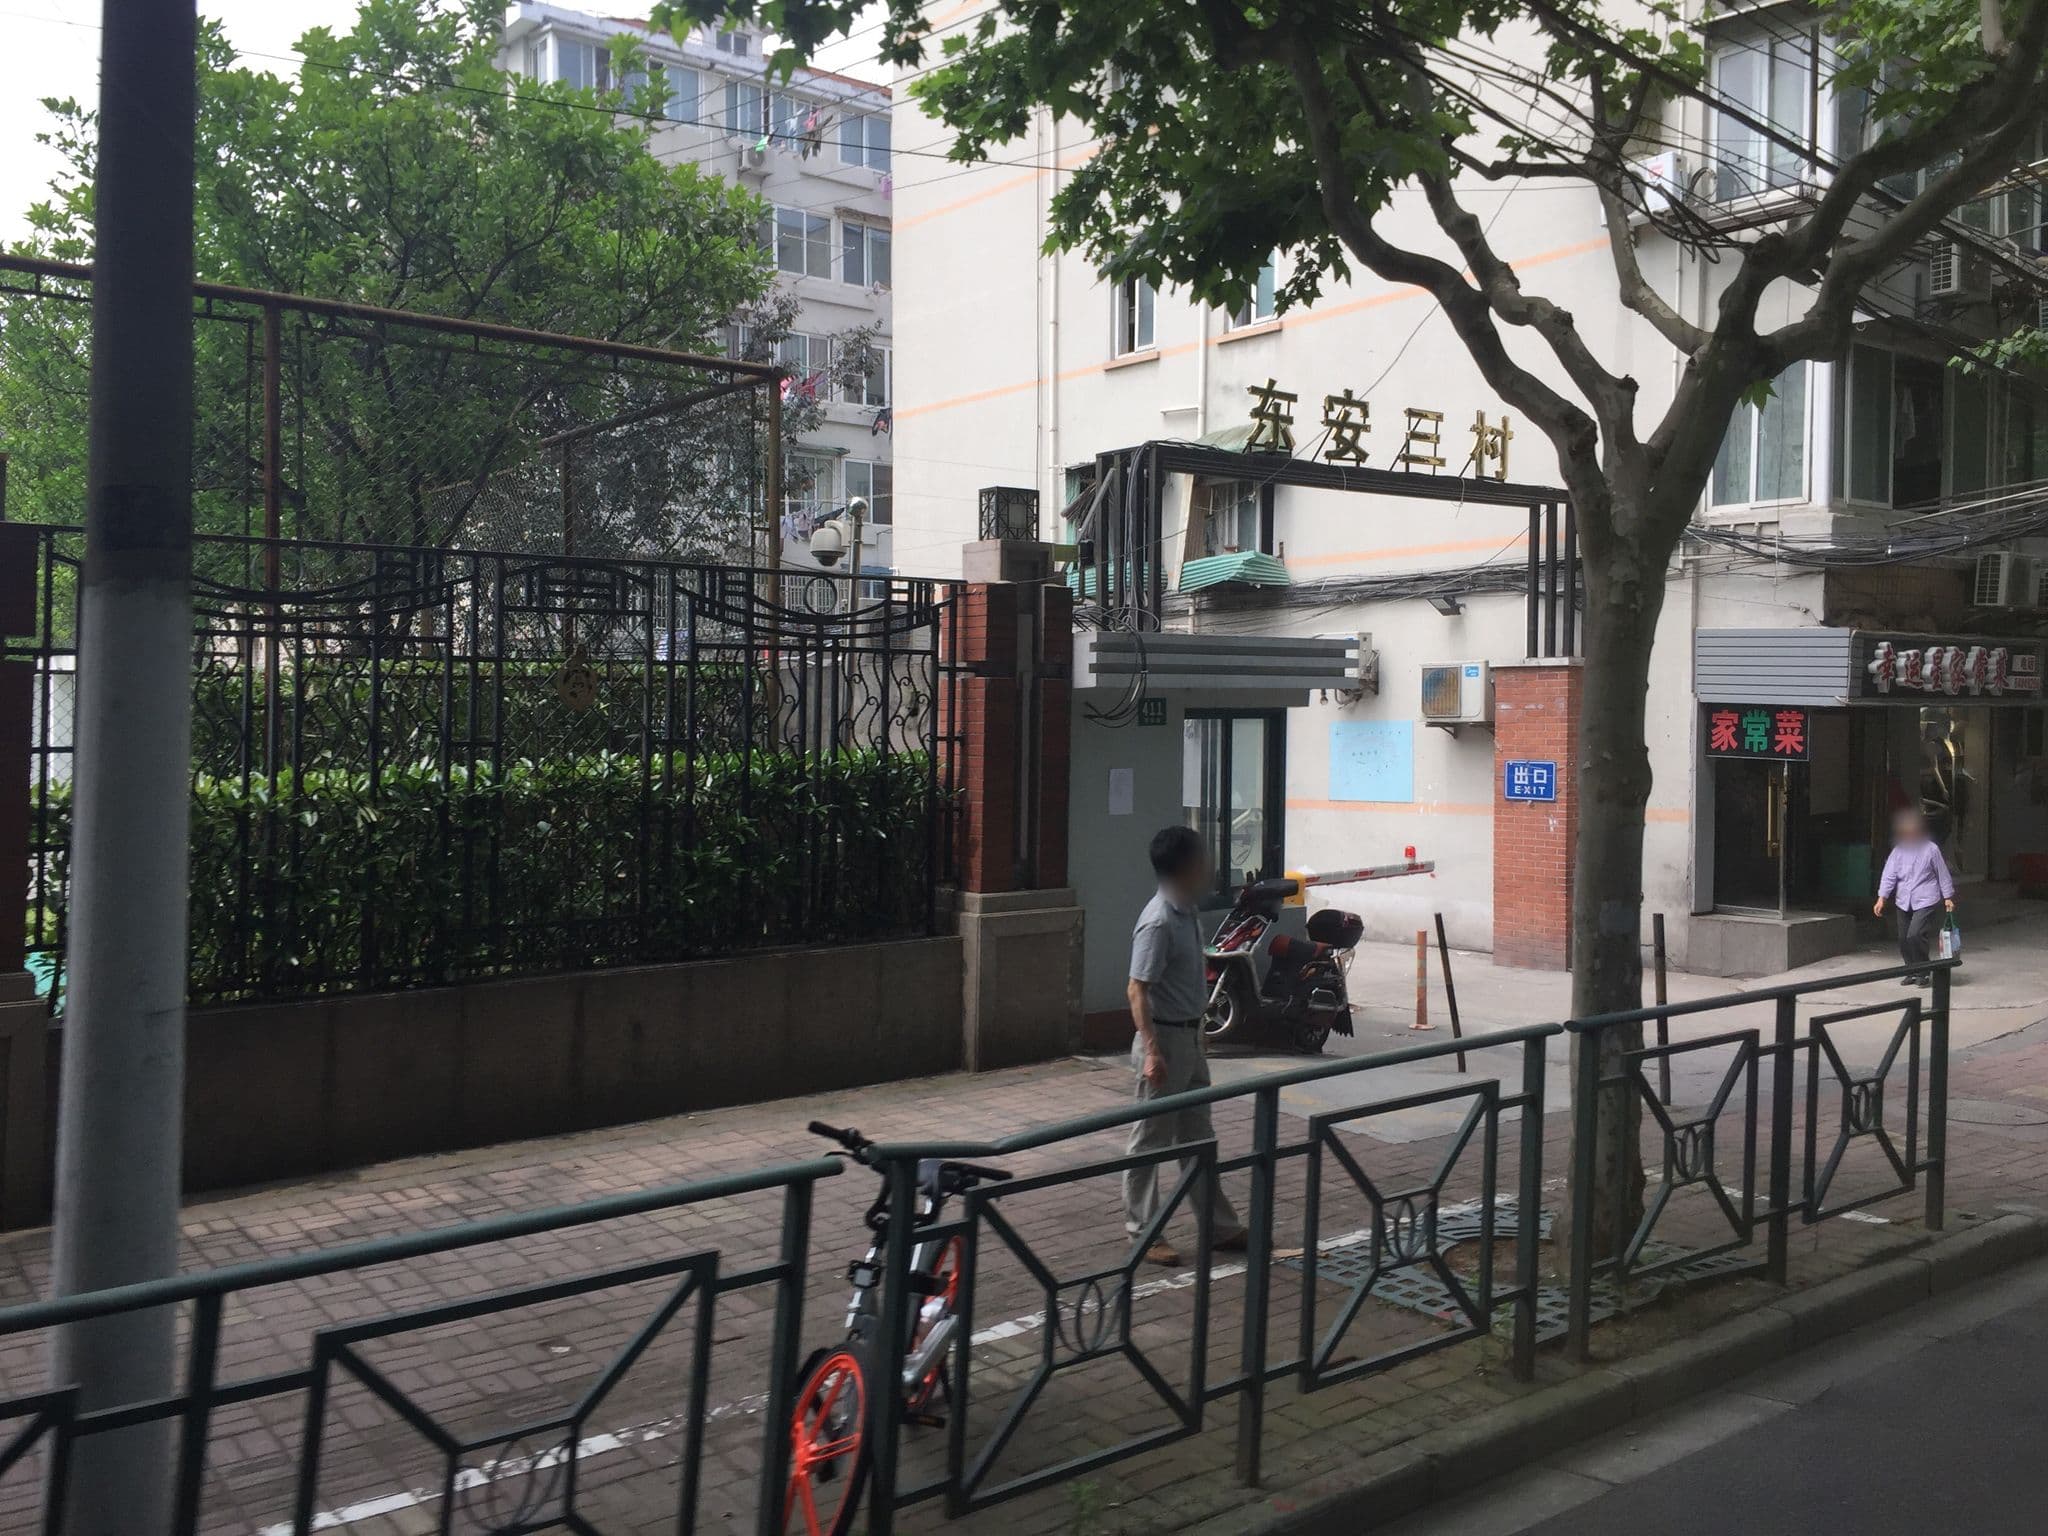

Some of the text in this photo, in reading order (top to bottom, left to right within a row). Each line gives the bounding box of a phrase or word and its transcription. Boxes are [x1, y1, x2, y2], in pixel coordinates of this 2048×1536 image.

[1247, 378, 1514, 481] 东安三村
[1710, 708, 1805, 755] 家常菜
[1514, 766, 1547, 785] 出口
[1514, 786, 1546, 795] EXIT
